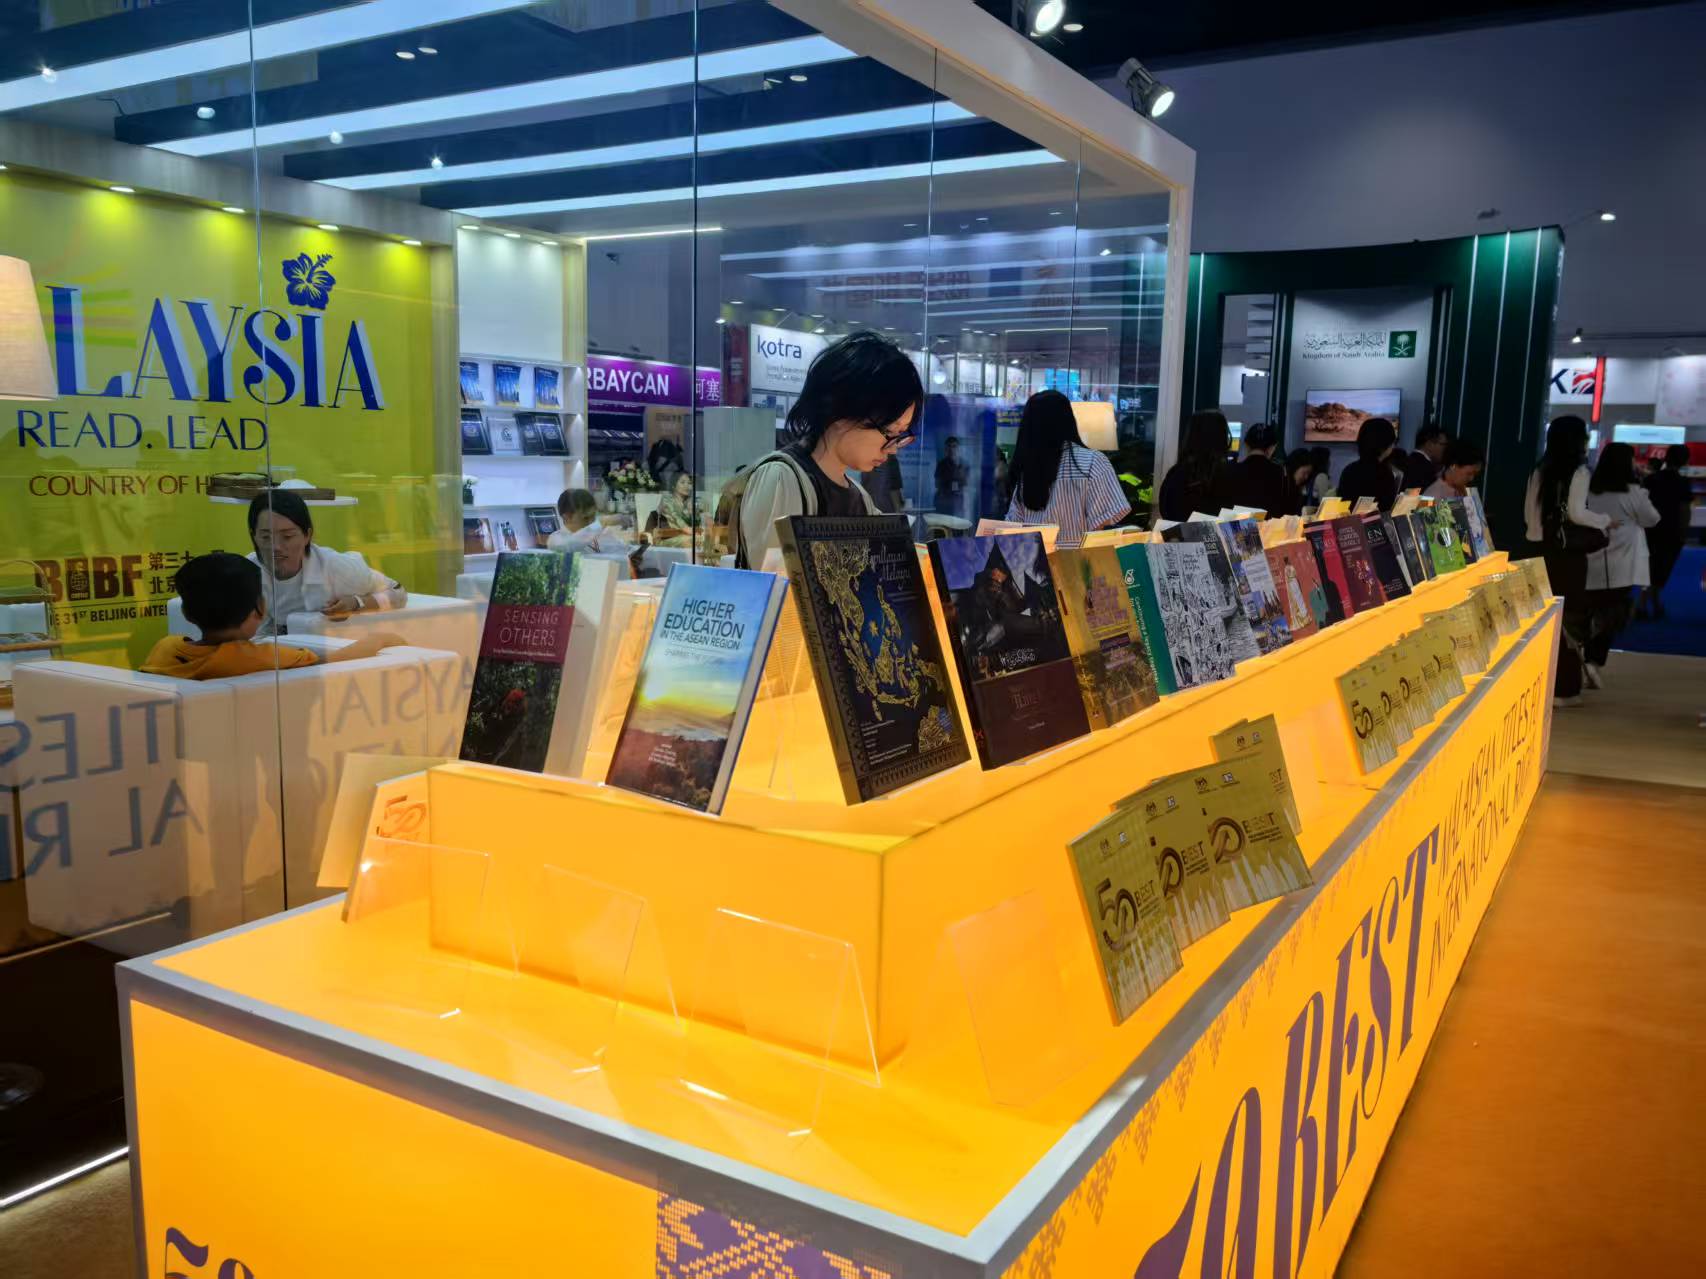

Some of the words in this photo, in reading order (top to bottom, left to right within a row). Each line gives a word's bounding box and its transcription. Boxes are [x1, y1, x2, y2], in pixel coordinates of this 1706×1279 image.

[757, 334, 802, 359] kotra
[1302, 352, 1333, 361] Kingdom
[17, 410, 153, 449] READ.
[167, 415, 268, 451] LEAD
[29, 475, 150, 497] COUNTRY
[158, 475, 189, 496] OF
[90, 606, 137, 622] BEIJING
[503, 608, 559, 625] SENSING
[682, 597, 735, 620] HIGHER
[499, 627, 555, 647] OTHERS
[664, 613, 745, 639] EDUCATION
[660, 630, 668, 639] IN
[670, 631, 685, 642] THE
[685, 633, 710, 645] ASEAN
[711, 637, 741, 650] REGION
[1499, 686, 1531, 772] TITLES
[1426, 773, 1511, 998] INTERNATIONAL
[1096, 877, 1139, 951] 50
[1272, 823, 1440, 1279] BEST
